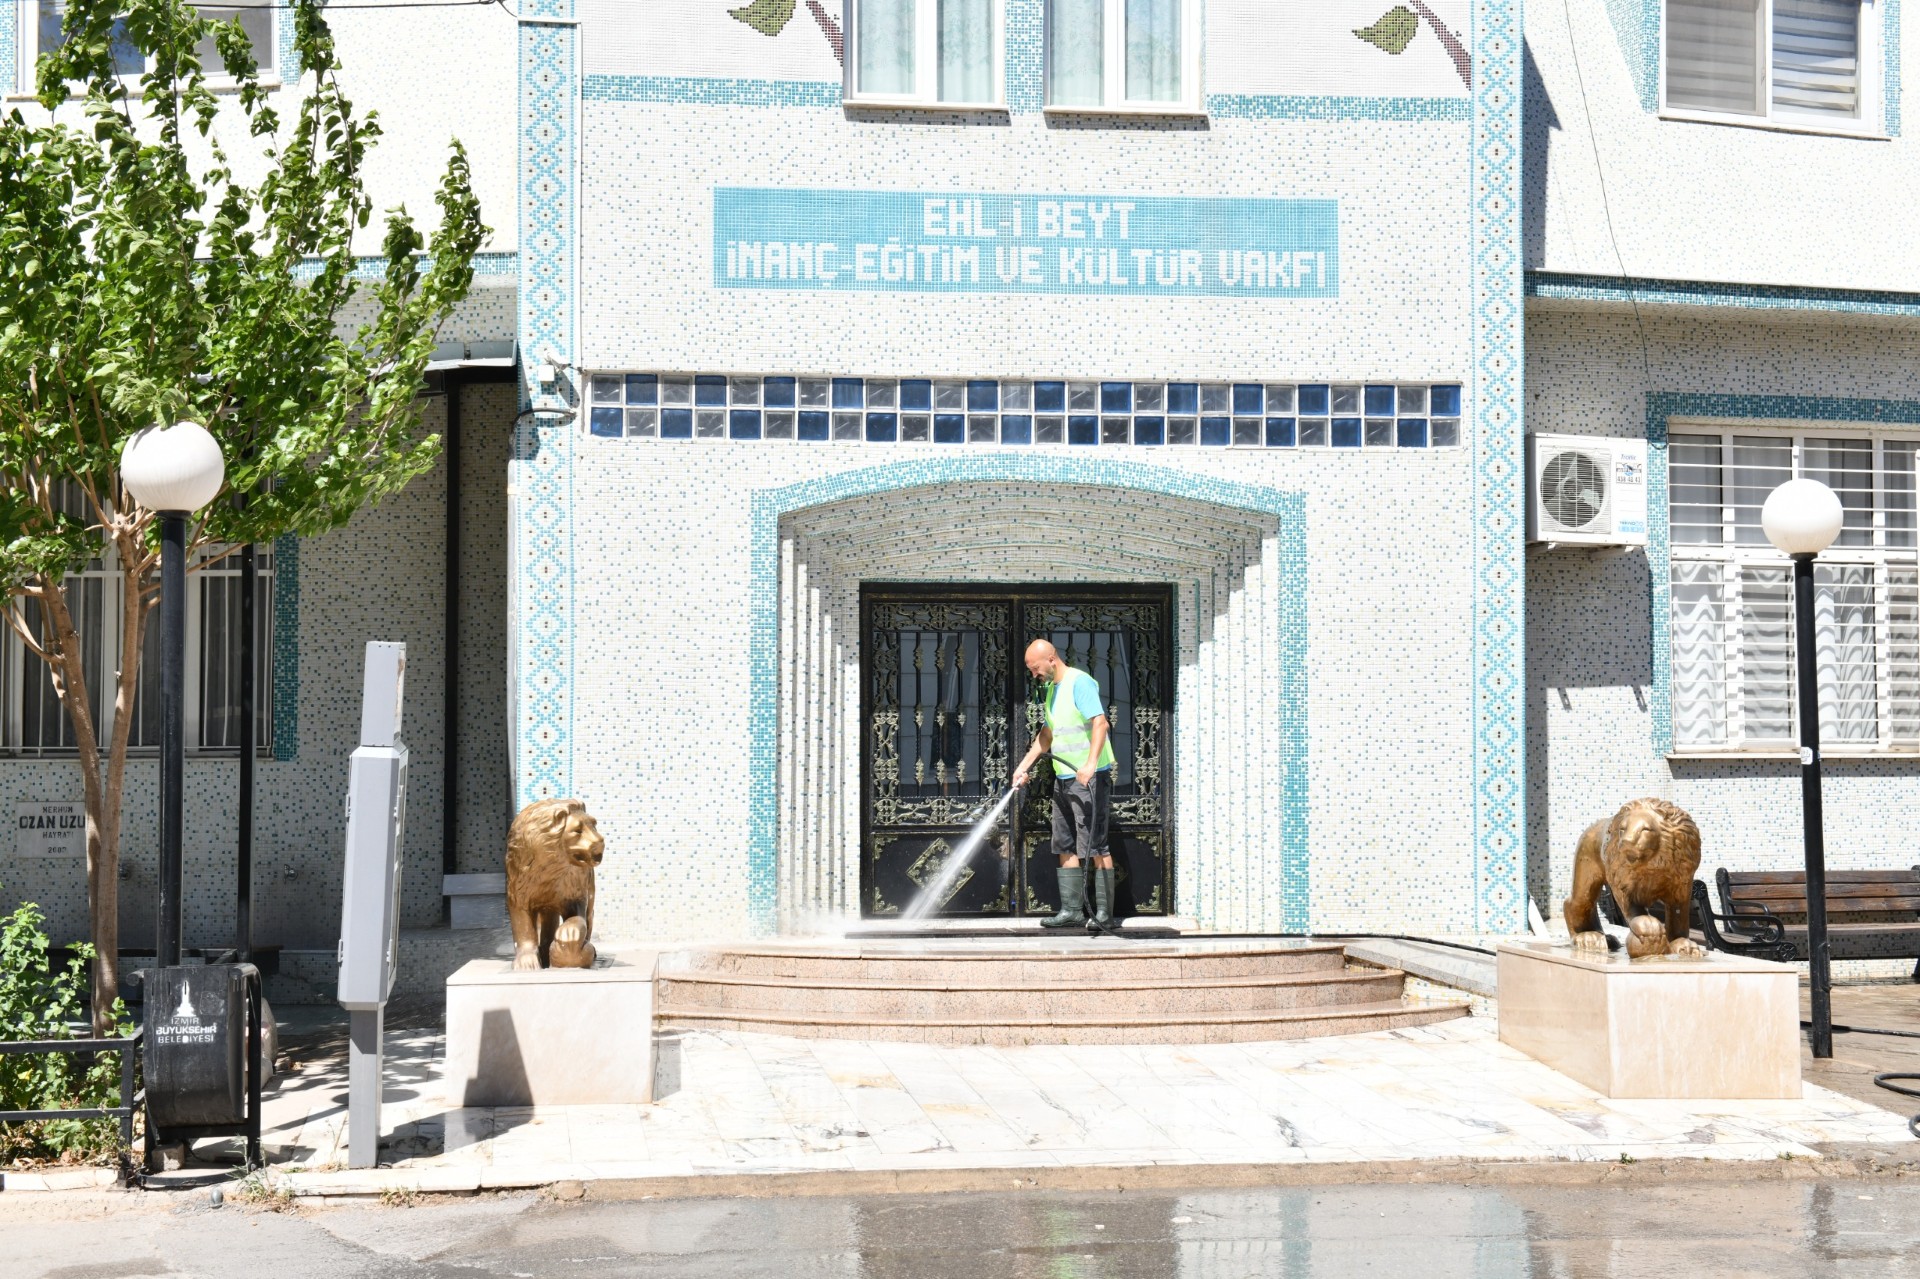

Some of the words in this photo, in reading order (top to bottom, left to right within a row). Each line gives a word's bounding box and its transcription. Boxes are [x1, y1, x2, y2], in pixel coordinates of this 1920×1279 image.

[1037, 200, 1136, 239] BEYT
[995, 246, 1044, 284] VE
[1059, 247, 1201, 286] KÜLTÜR
[1218, 249, 1326, 288] VAKFI
[19, 815, 56, 829] OZAN
[59, 815, 86, 829] UZU
